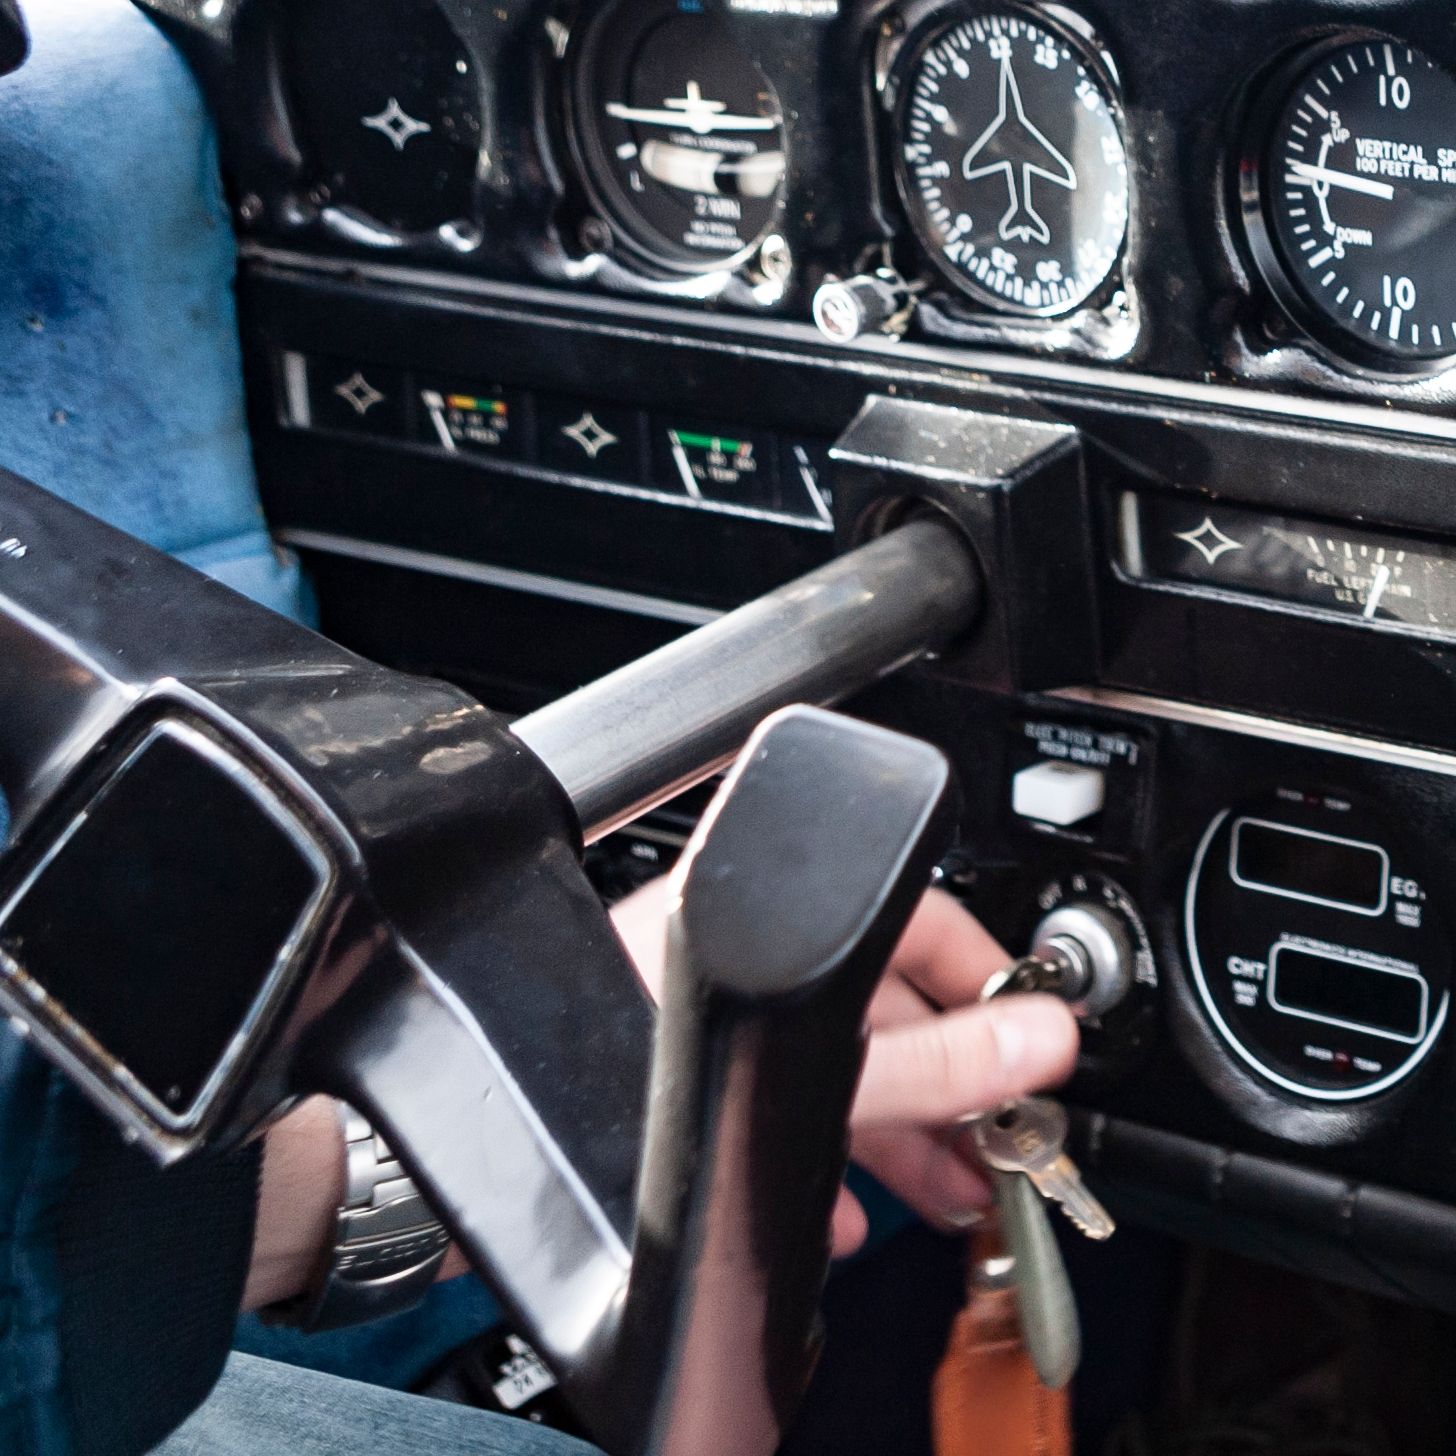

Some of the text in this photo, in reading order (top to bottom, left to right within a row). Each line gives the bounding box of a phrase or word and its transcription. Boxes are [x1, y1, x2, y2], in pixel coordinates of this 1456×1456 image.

[1379, 74, 1411, 110] 10
[1330, 111, 1341, 129] 5
[1331, 128, 1351, 144] UP
[1355, 137, 1428, 165] VERTICAL
[1356, 156, 1379, 174] 100
[1380, 159, 1411, 178] FEET
[1413, 163, 1439, 182] PER
[1336, 226, 1373, 246] DOWN
[1383, 274, 1416, 311] 10
